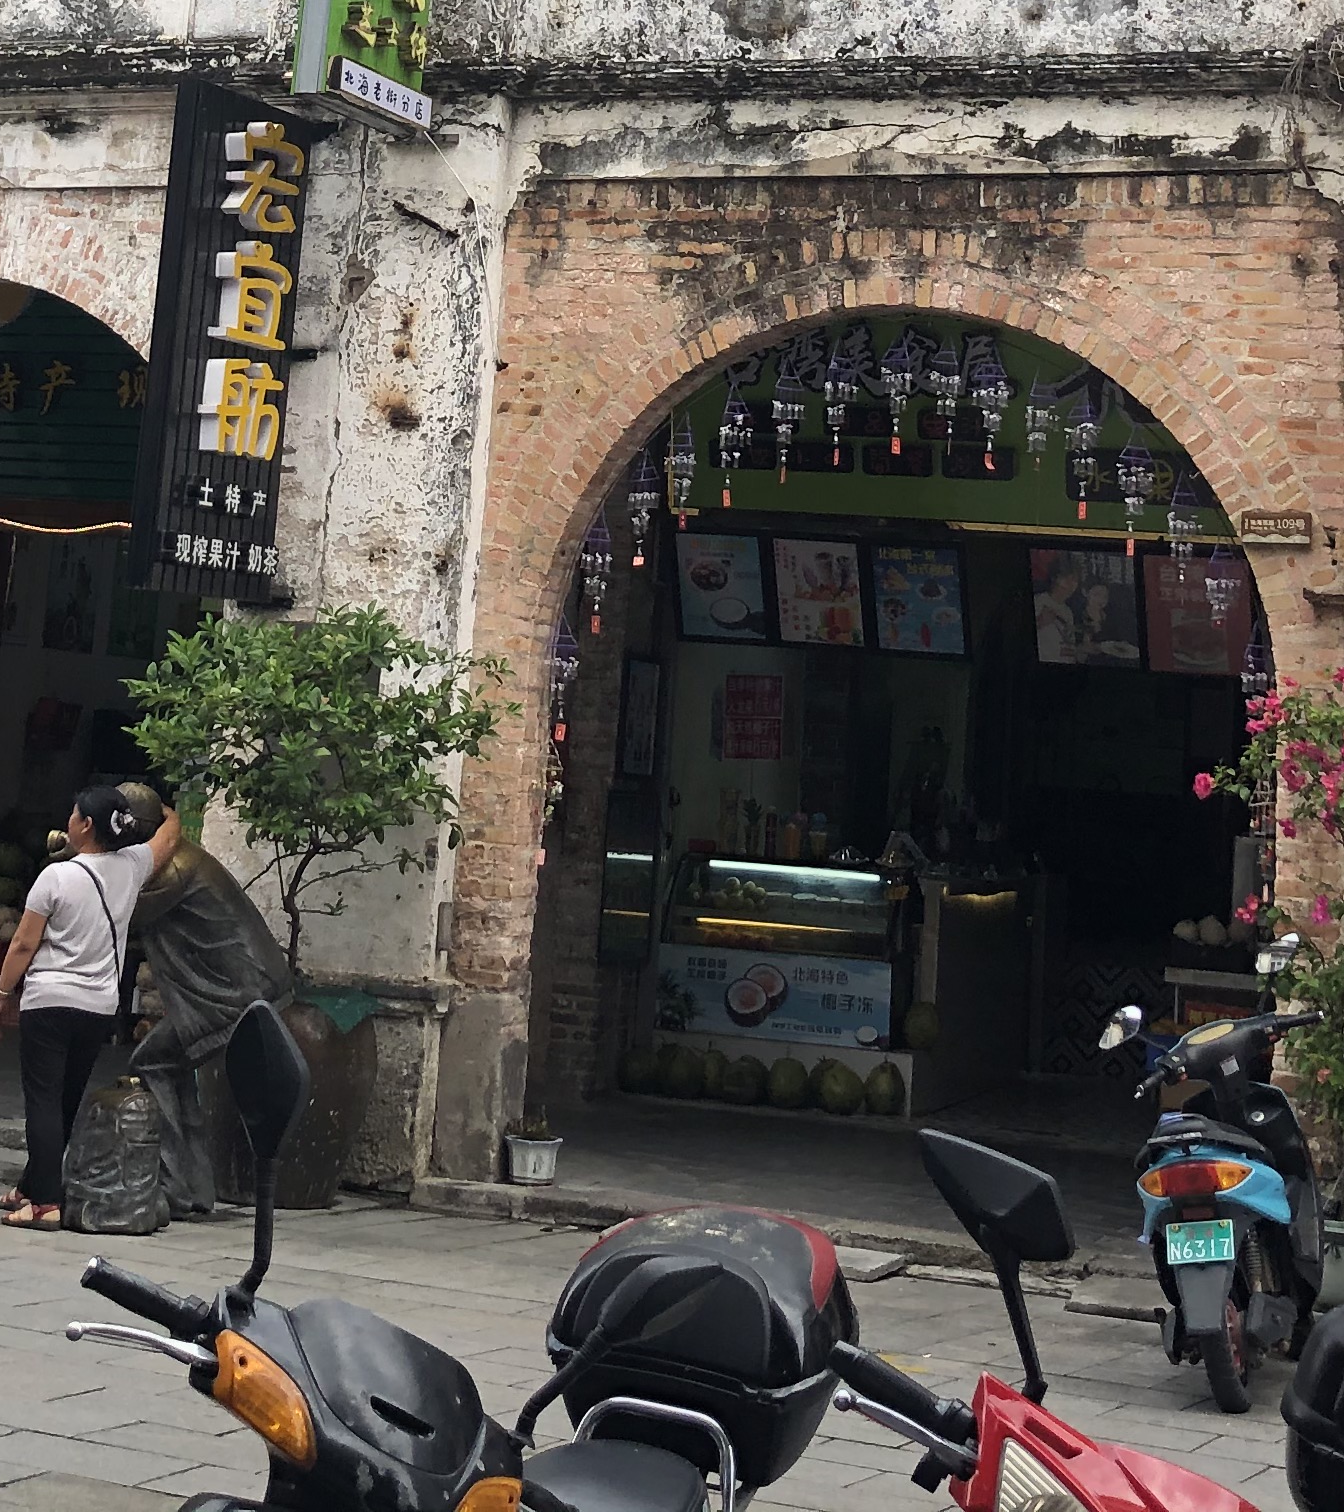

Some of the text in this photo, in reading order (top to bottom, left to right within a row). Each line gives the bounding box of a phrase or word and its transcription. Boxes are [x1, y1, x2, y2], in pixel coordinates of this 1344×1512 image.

[198, 478, 267, 517] 土特产
[175, 533, 278, 575] 现榨果汁 奶茶
[792, 966, 849, 986] 北海特色
[1170, 1237, 1231, 1261] N6317
